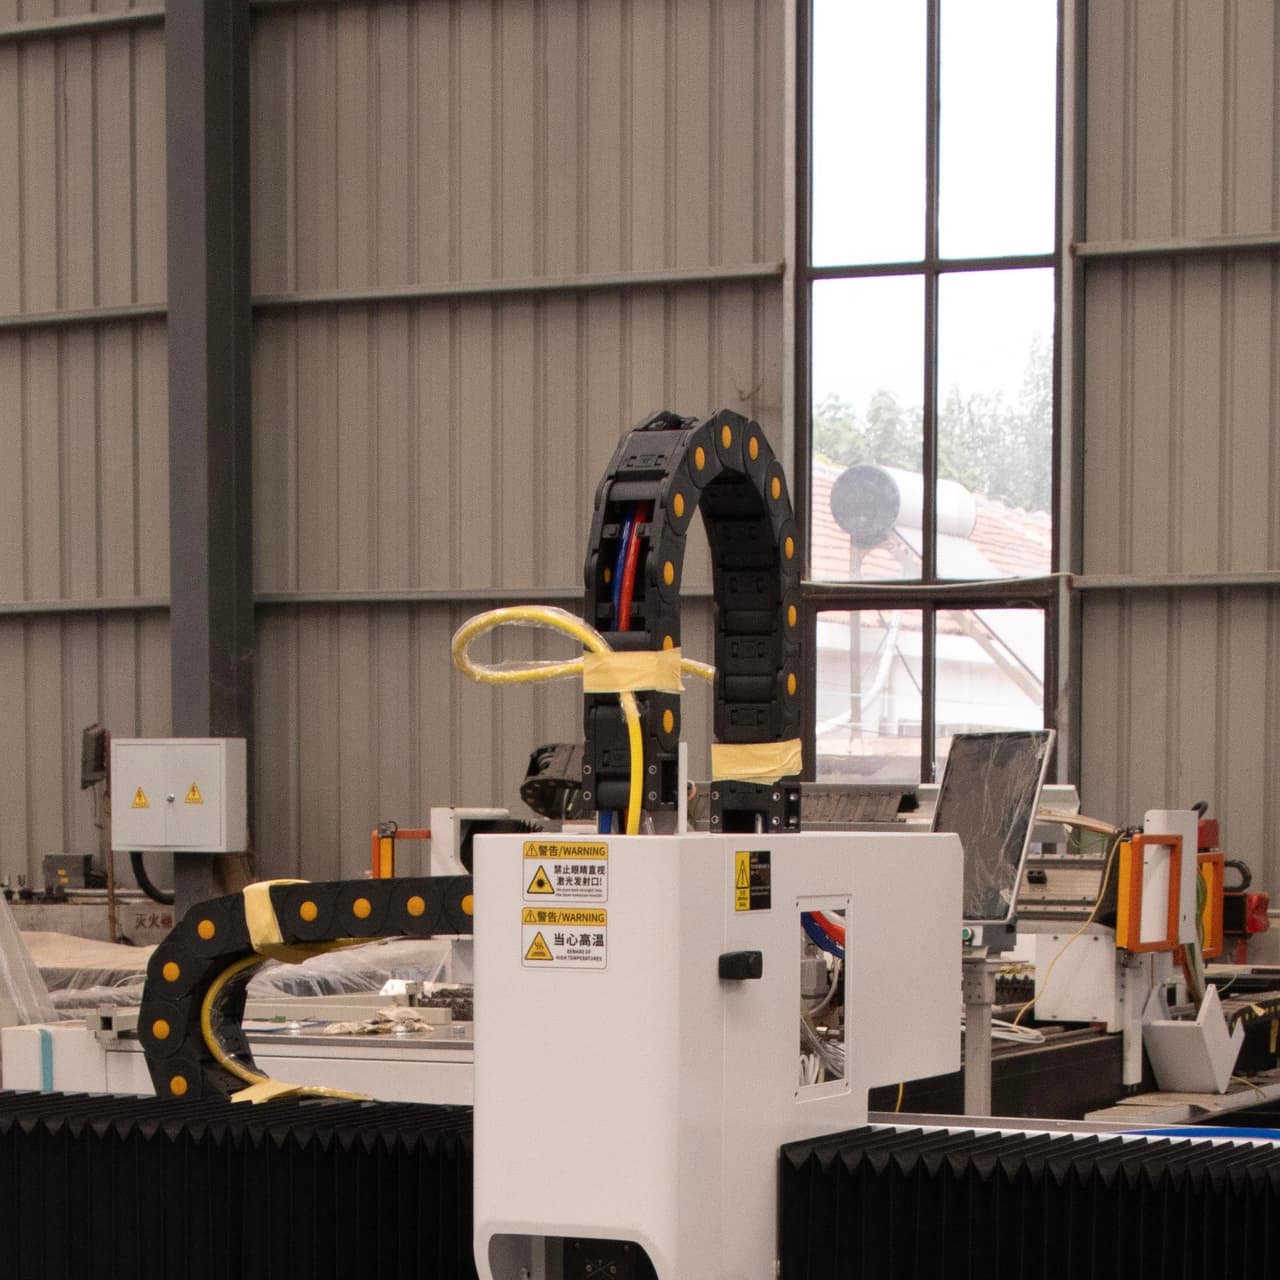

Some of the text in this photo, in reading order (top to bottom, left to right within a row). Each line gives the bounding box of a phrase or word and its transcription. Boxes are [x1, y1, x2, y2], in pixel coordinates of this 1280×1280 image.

[538, 845, 606, 857] 警告/WARNING
[554, 865, 605, 875] 禁止眼睛直视
[537, 911, 605, 923] 警告/WARNING
[554, 933, 604, 947] 当心高温
